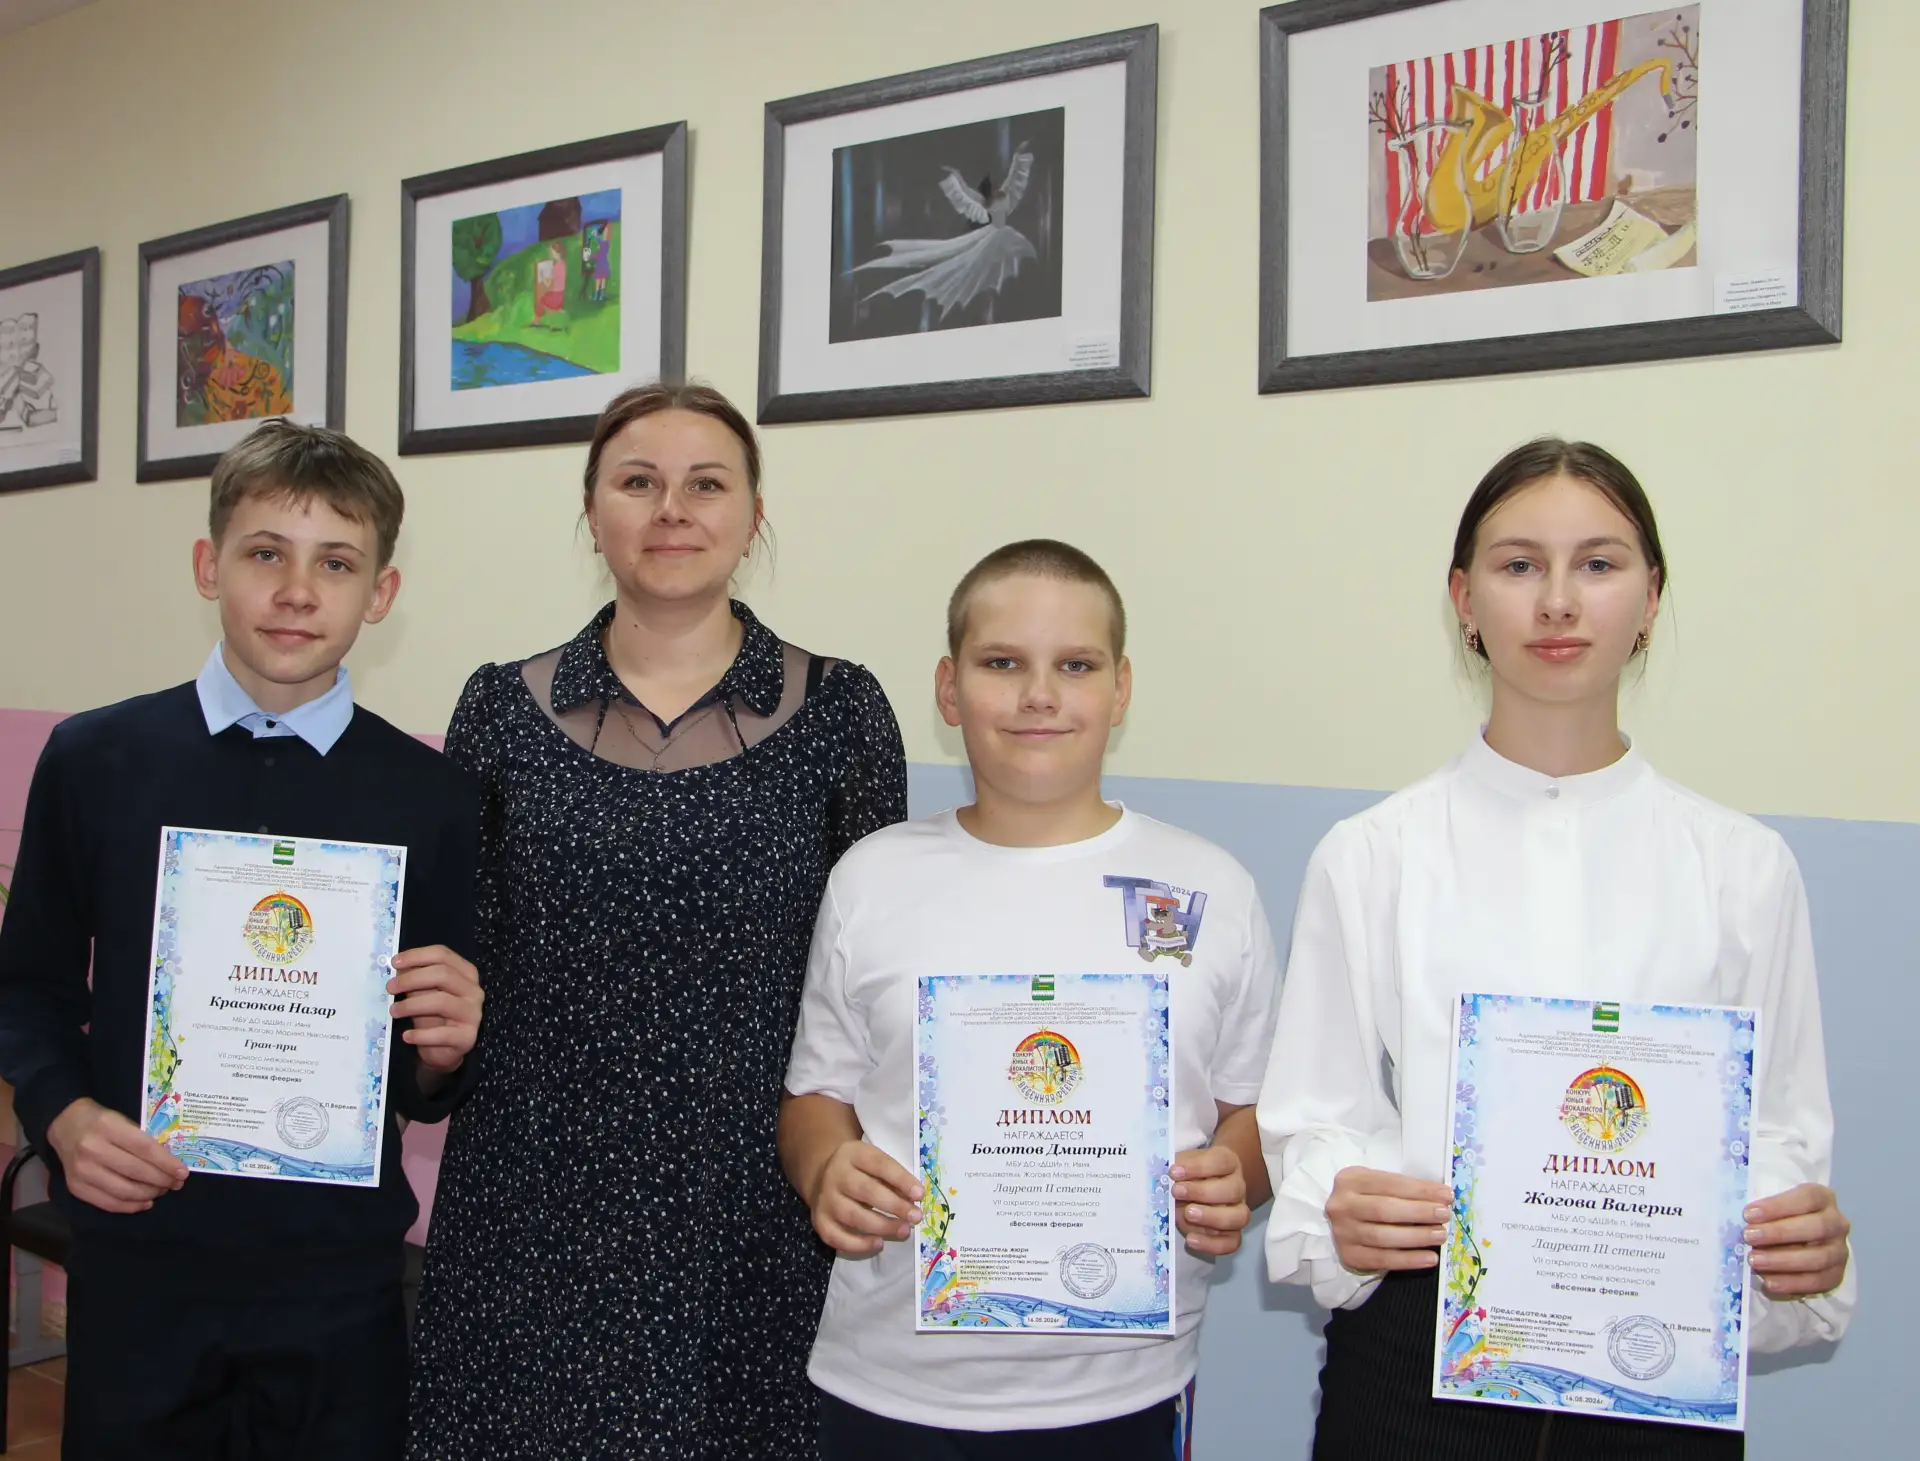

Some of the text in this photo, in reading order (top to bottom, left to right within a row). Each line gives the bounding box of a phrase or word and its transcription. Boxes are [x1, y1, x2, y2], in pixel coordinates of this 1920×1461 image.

[228, 964, 318, 988] ДИПЛОМ
[235, 985, 309, 1000] НАГРАЖДАЕТСЯ
[209, 996, 336, 1019] Красюков Назар
[244, 1038, 297, 1053] Гран-при
[996, 1110, 1091, 1126] ДИПЛОМ
[1004, 1131, 1084, 1140] НАГРАЖДАЕТСЯ
[971, 1143, 1128, 1158] Болотов Дмитрий
[1542, 1153, 1655, 1181] ДИПЛОМ
[993, 1184, 1042, 1194] Лауреат
[1045, 1184, 1054, 1193] II
[1550, 1178, 1645, 1196] НАГРАЖДАЕТСЯ
[1522, 1191, 1684, 1220] Жогова Валерия
[1551, 1213, 1570, 1222] МБУ
[1571, 1215, 1586, 1223] ДО
[1630, 1220, 1651, 1229] Ивня
[1501, 1222, 1700, 1246] преподаватель Жогова Марина Николаевна
[1531, 1238, 1667, 1260] Лауреат III степени
[1532, 1256, 1544, 1264] VII
[1545, 1258, 1589, 1269] открытого
[1536, 1269, 1656, 1287] конкурса юных вокалистов
[1551, 1282, 1639, 1299] «Весенняя феерия»
[1490, 1306, 1547, 1318] Председатель
